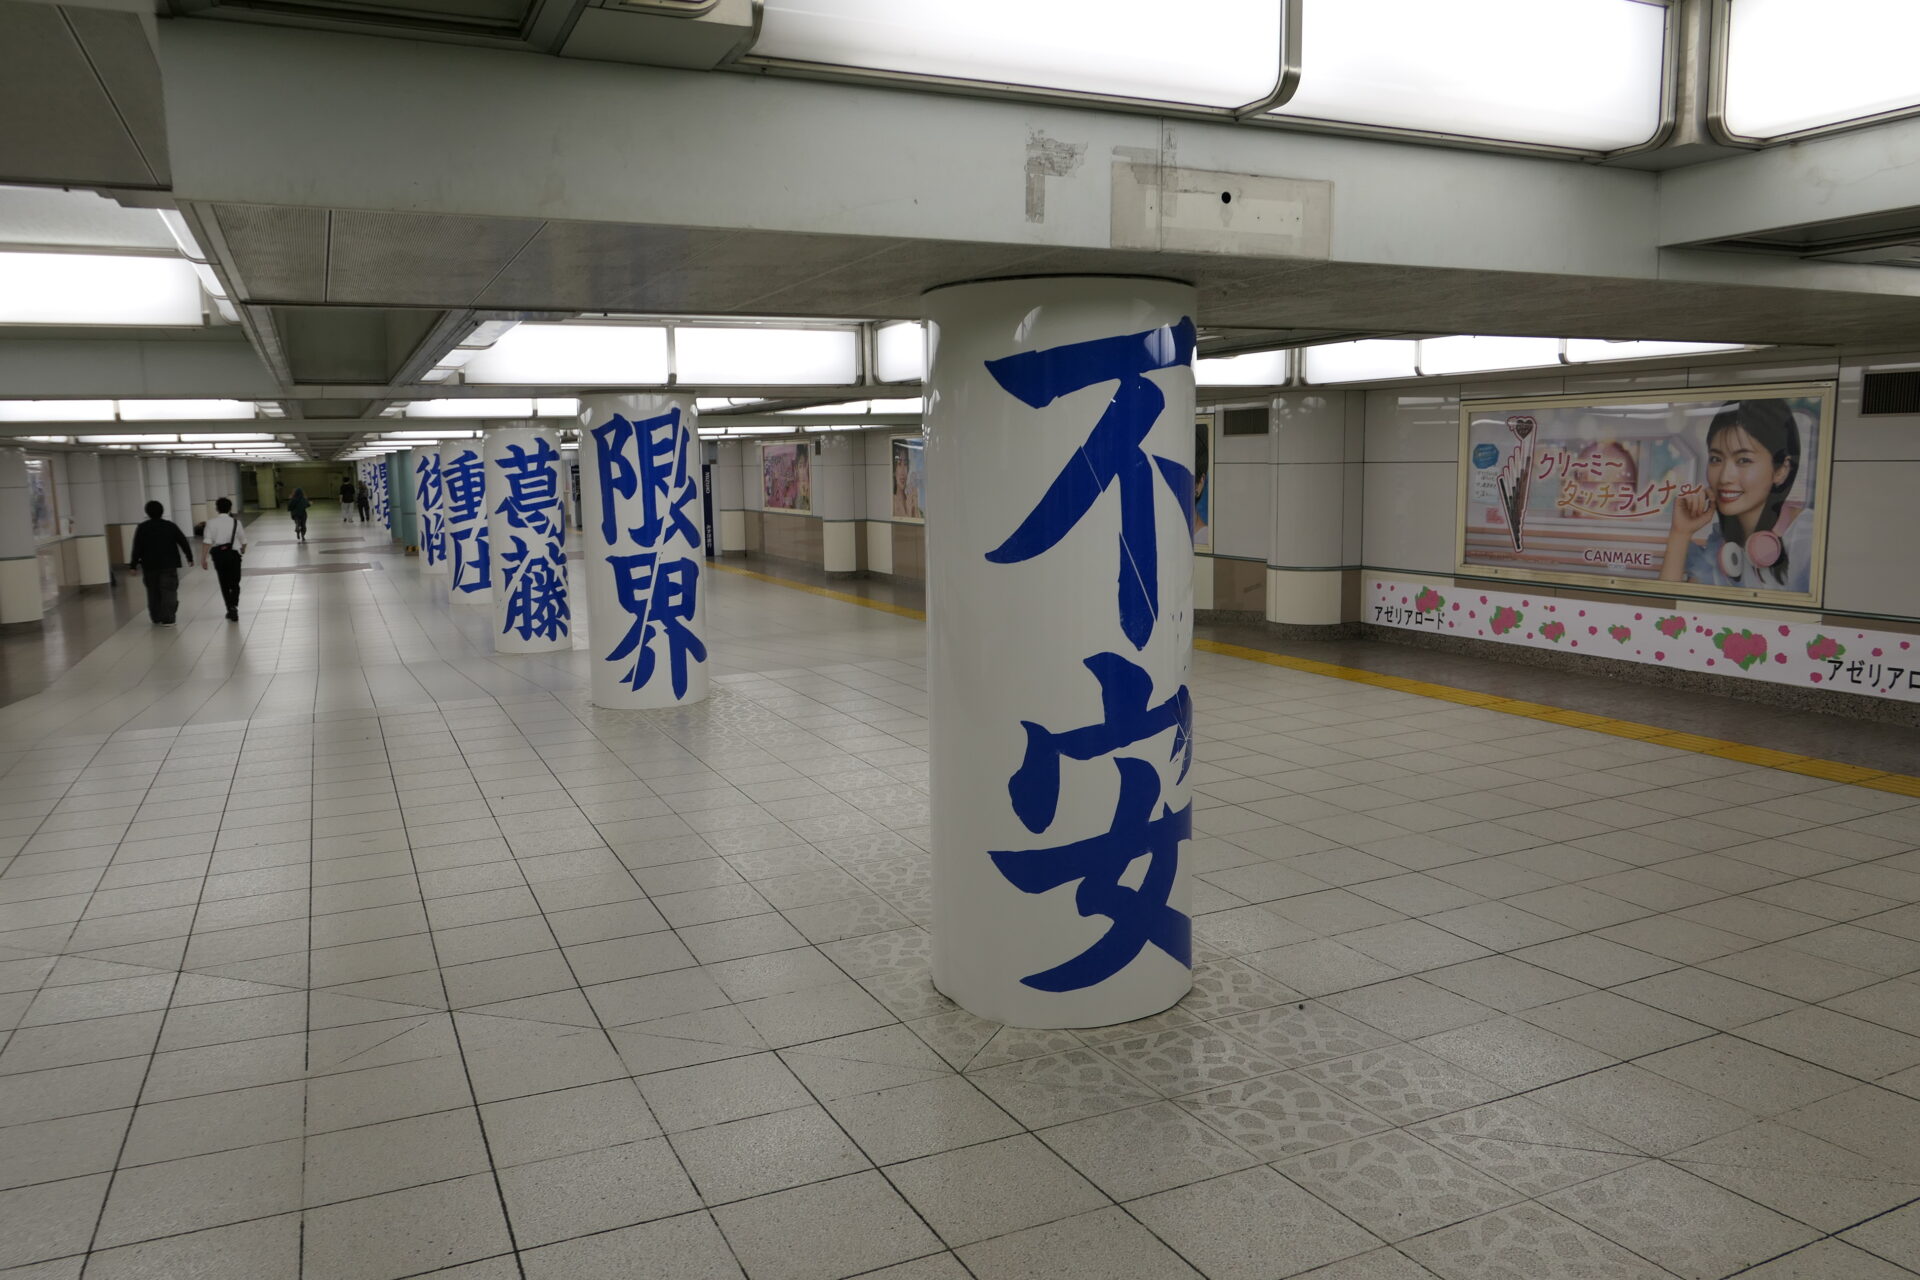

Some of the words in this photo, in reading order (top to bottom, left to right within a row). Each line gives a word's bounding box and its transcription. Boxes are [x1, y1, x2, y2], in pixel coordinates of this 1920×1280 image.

[442, 450, 492, 593] 重圧
[495, 437, 571, 642] 葛藤
[590, 407, 707, 700] 限界
[1584, 549, 1652, 566] CANMAKE
[984, 316, 1196, 993] 不安
[1374, 605, 1445, 630] アゼリアロード
